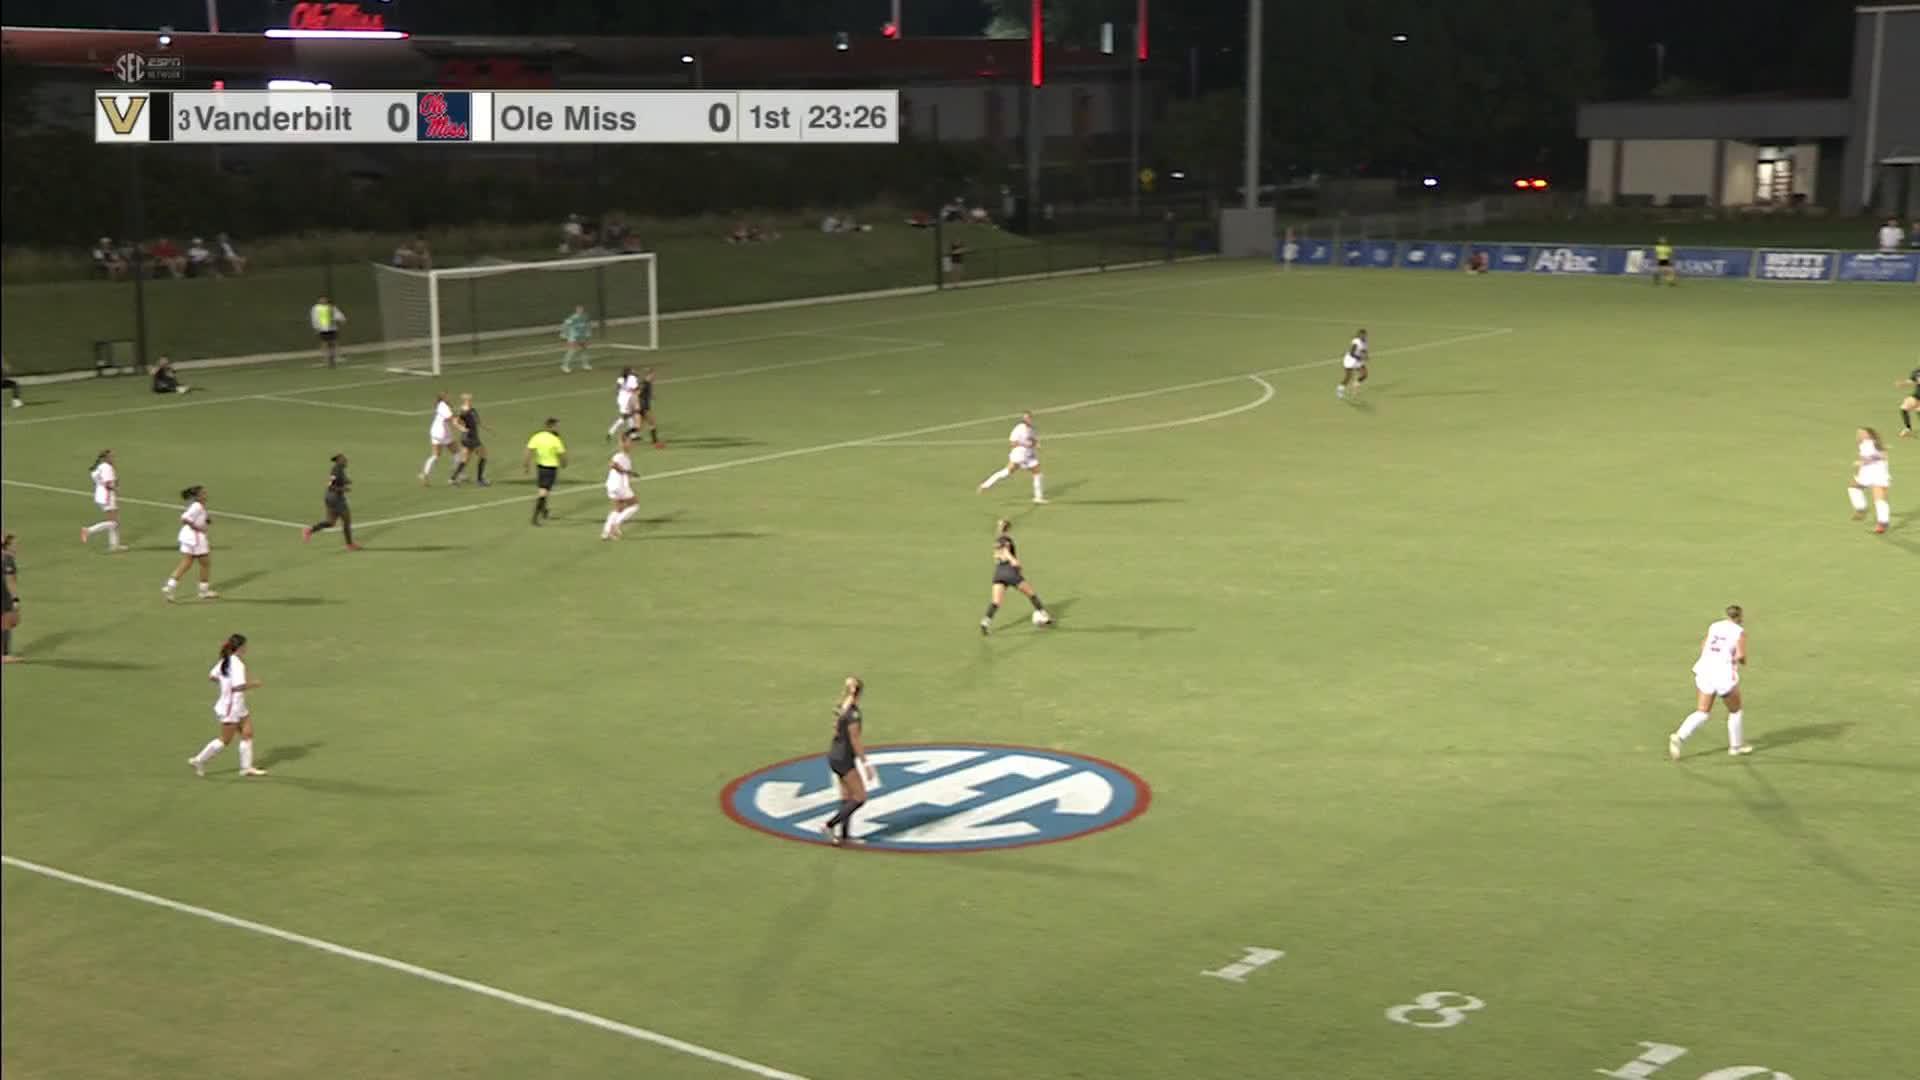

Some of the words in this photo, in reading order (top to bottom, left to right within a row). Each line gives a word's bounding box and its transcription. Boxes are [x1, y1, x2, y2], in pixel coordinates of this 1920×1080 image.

[1534, 248, 1597, 272] Aflac
[754, 749, 1113, 843] SEC
[1200, 946, 1286, 983] 1
[1386, 991, 1488, 1028] 8
